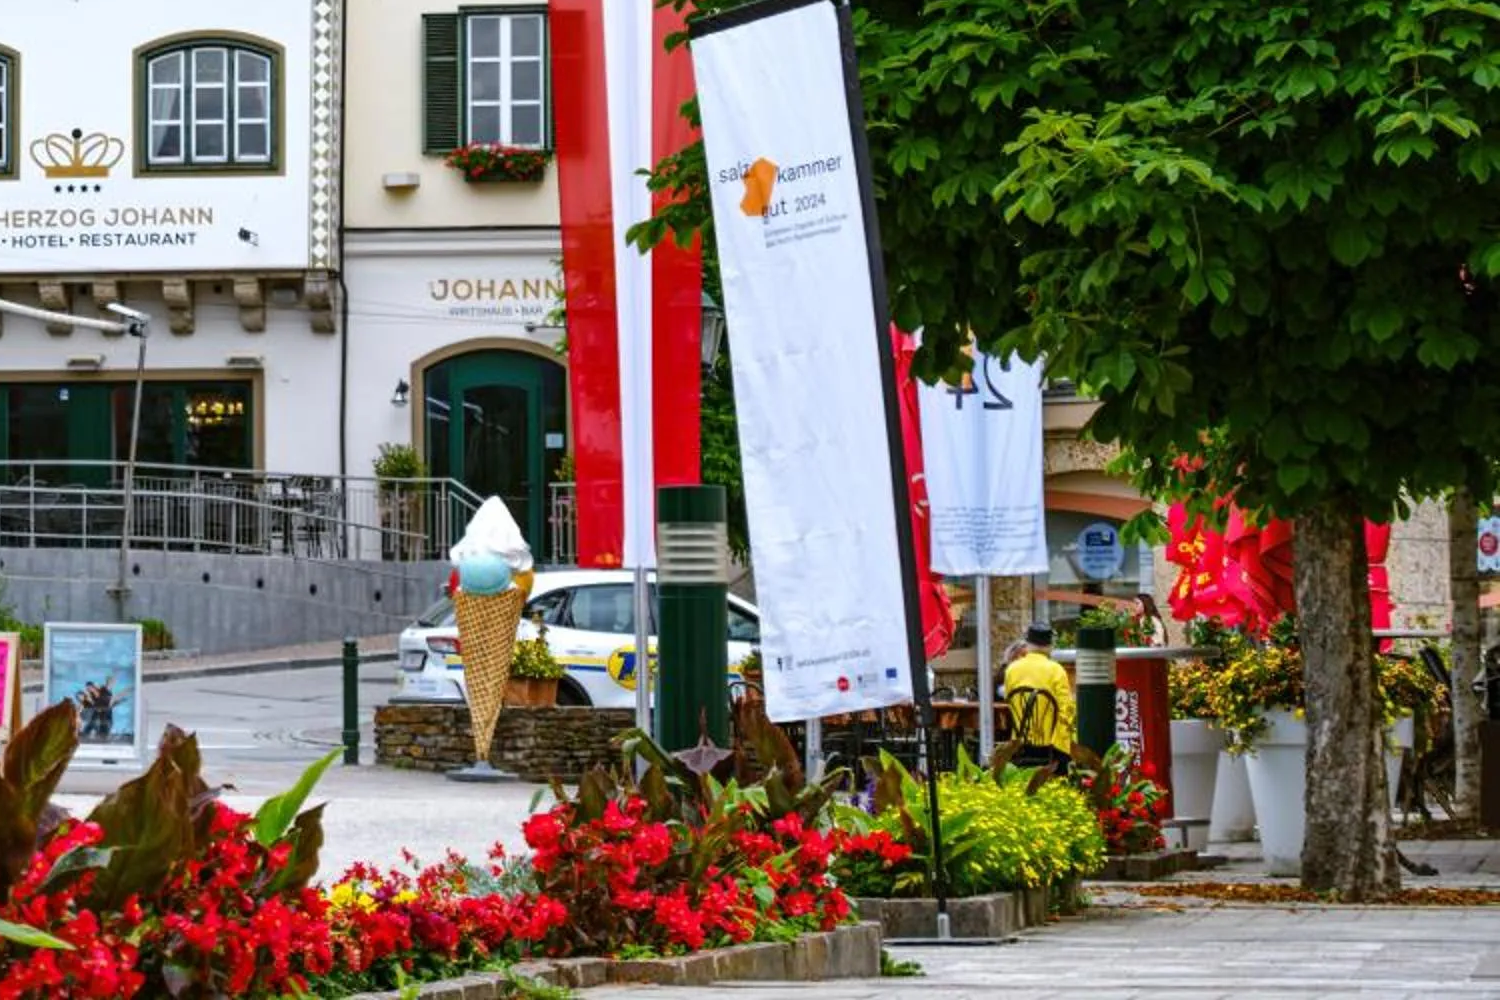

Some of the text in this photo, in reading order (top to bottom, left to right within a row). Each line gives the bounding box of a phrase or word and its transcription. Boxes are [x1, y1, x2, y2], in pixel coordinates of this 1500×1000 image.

[775, 155, 842, 184] kammer
[794, 192, 826, 213] 2024
[103, 207, 214, 227] JOHANN
[79, 231, 197, 247] RESTAURANT
[430, 279, 562, 301] JOHANN
